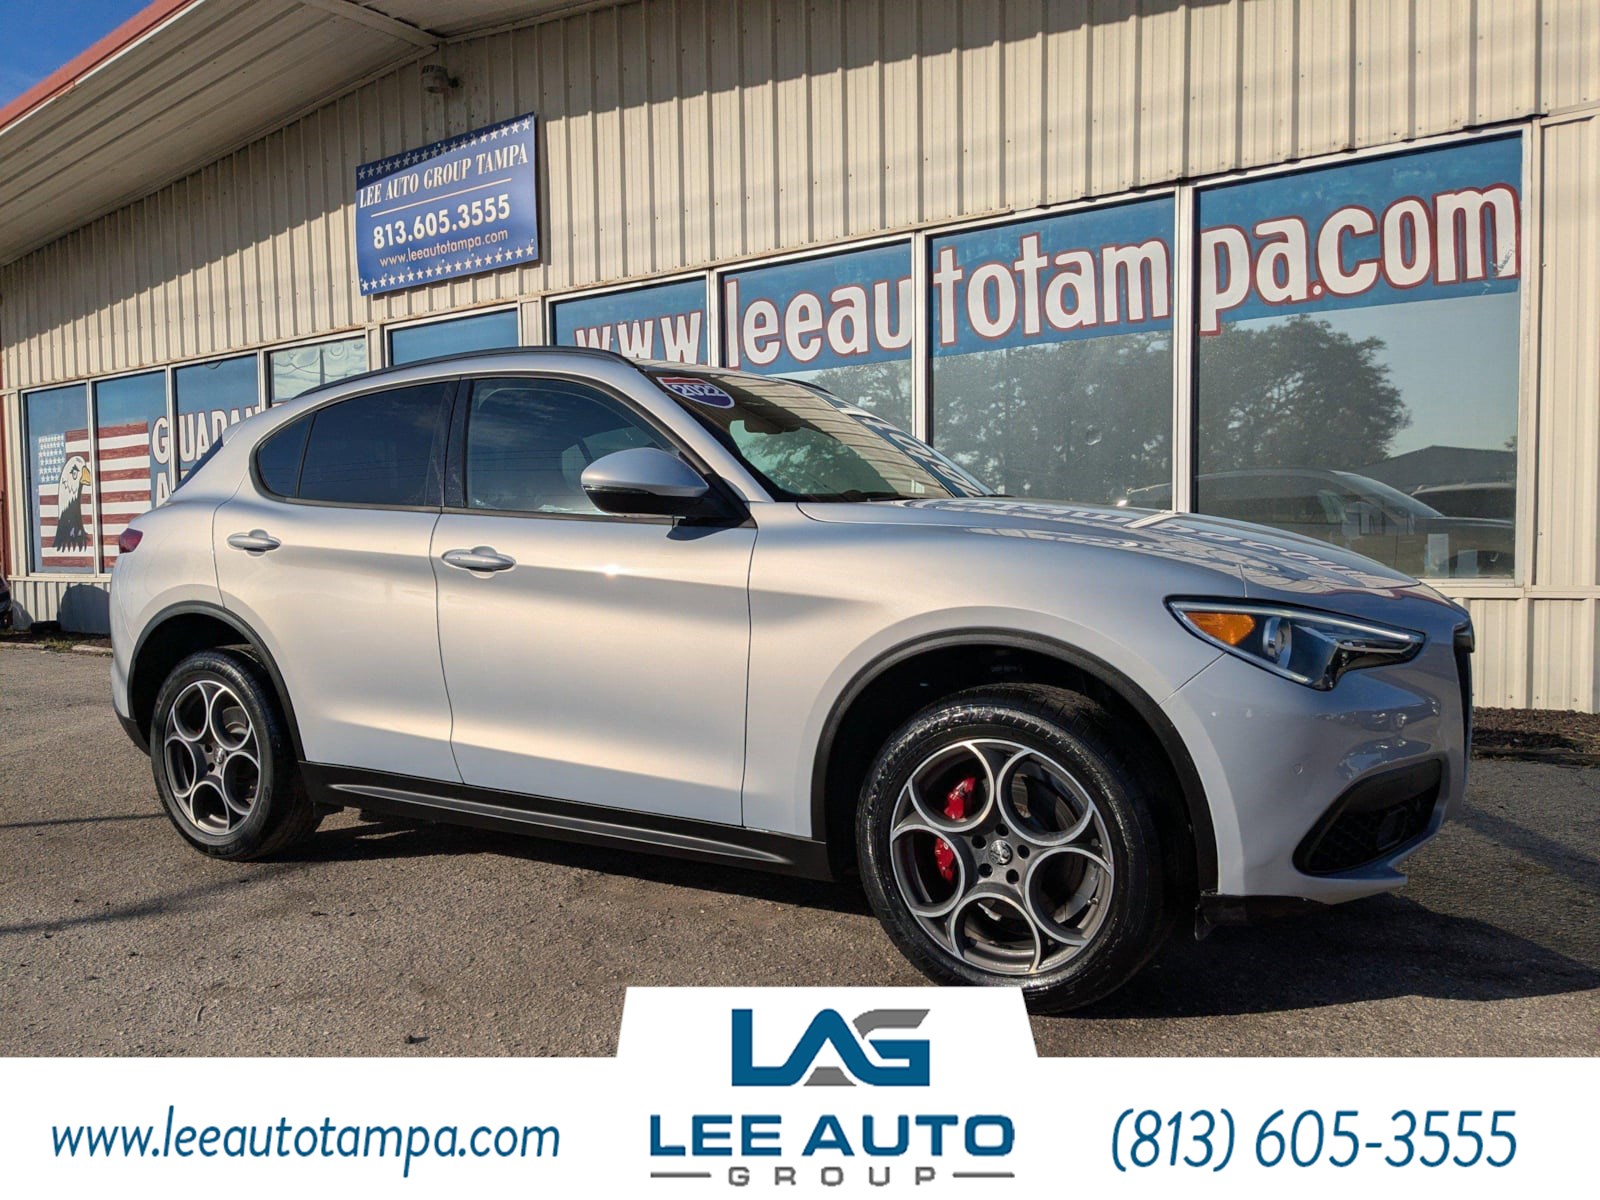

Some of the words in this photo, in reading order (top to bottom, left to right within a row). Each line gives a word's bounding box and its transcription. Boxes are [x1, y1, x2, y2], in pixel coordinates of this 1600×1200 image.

[359, 183, 382, 208] LEE
[385, 173, 419, 201] AUTO
[423, 158, 472, 190] GROUP
[476, 143, 528, 176] TAMPA
[373, 194, 511, 249] 813.605.3555
[379, 229, 508, 267] www.leeautotampa.com
[671, 384, 727, 397] 2022
